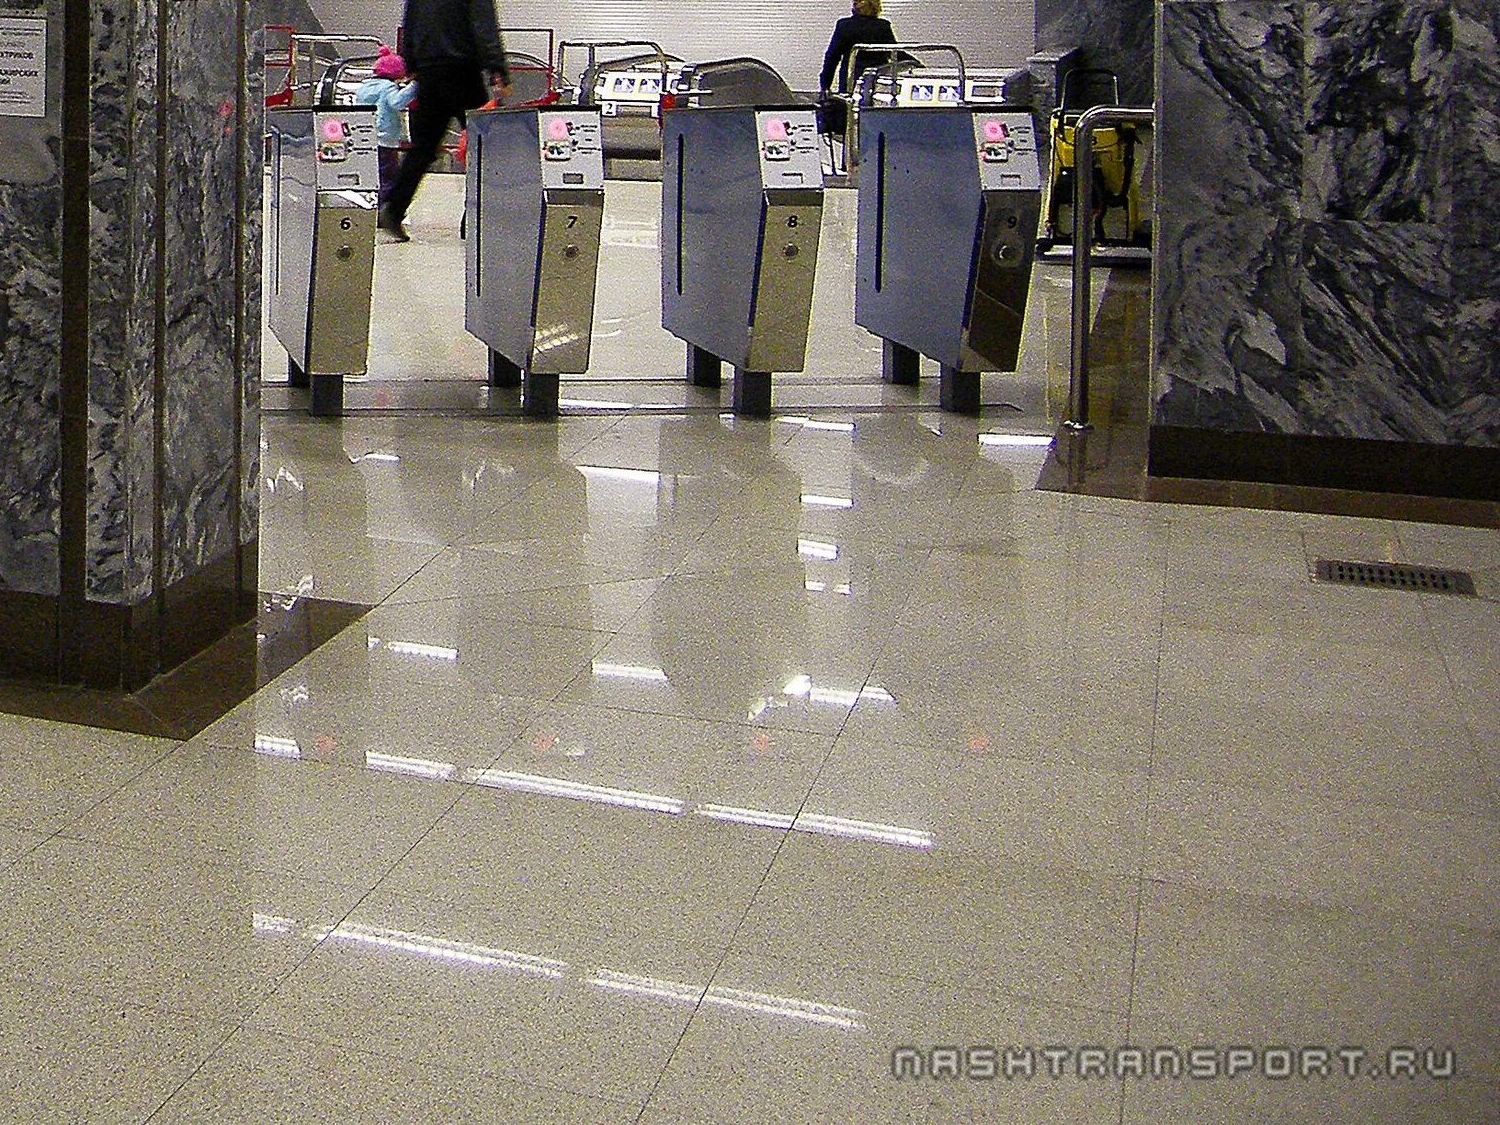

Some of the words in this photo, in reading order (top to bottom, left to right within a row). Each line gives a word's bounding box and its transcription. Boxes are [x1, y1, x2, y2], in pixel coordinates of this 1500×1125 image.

[605, 103, 613, 115] 2
[340, 217, 350, 230] 6
[567, 215, 578, 229] 7
[787, 215, 798, 228] 8
[1007, 216, 1017, 228] 9
